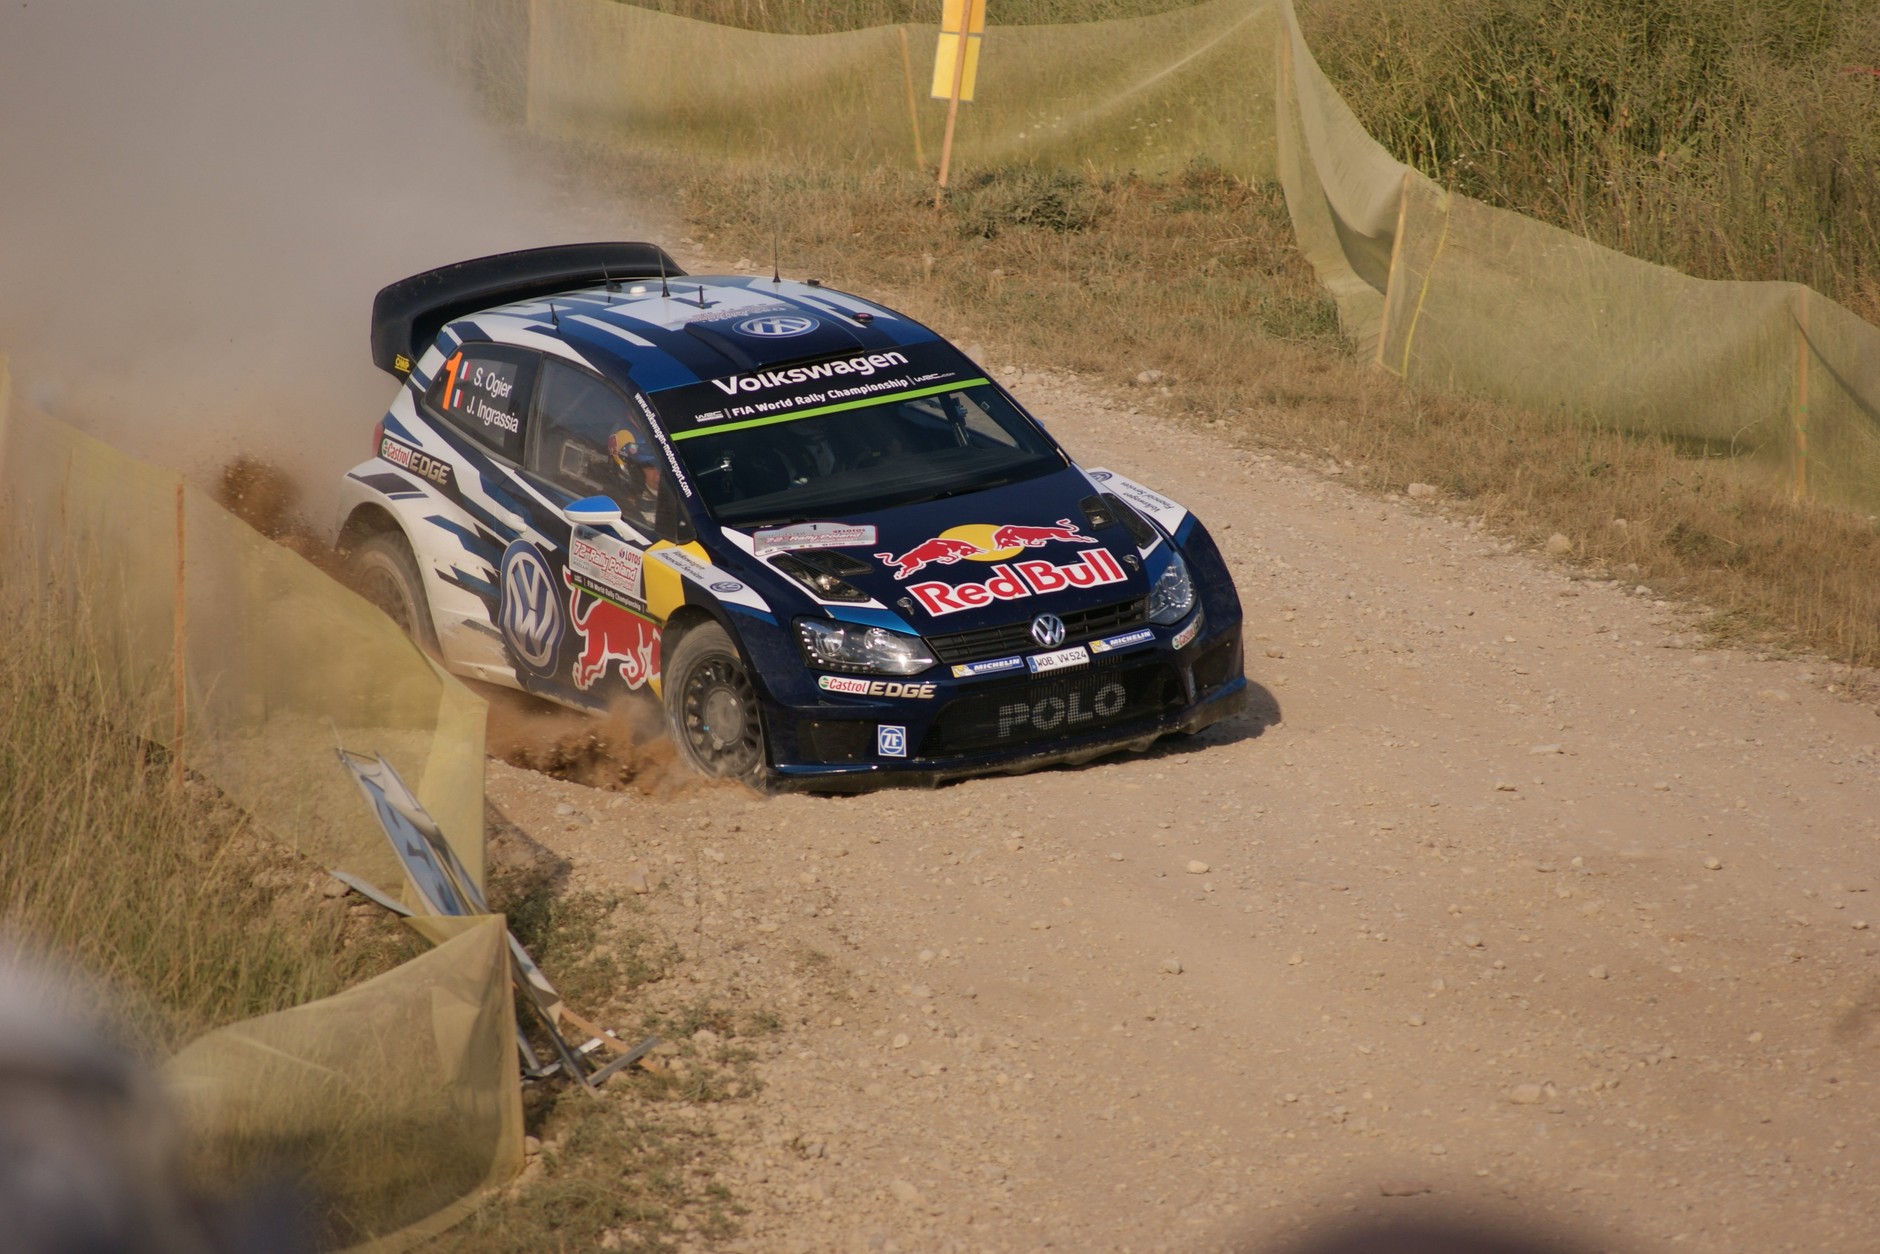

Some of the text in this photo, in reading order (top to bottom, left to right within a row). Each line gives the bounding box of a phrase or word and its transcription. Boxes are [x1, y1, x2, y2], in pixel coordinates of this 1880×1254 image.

[442, 352, 463, 411] 1
[473, 367, 513, 398] S. Ogier
[711, 351, 909, 395] Volkswagen
[466, 396, 519, 434] J. Ingrassia
[731, 405, 756, 417] FIA
[755, 398, 794, 412] World
[795, 392, 827, 406] Rally
[827, 378, 909, 399] Championship
[634, 392, 693, 498] www.volkswagen-motorsport.com
[409, 451, 451, 485] EDGE
[589, 547, 610, 573] Rally
[608, 556, 638, 582] Poland
[908, 548, 1128, 617] Red Bull
[1108, 630, 1151, 645] MICHELIN
[973, 657, 1021, 672] MICHELIN
[1036, 656, 1054, 667] WOB
[829, 678, 938, 699] Castrol EDGE
[998, 683, 1127, 738] POLO
[881, 731, 902, 751] ZF
